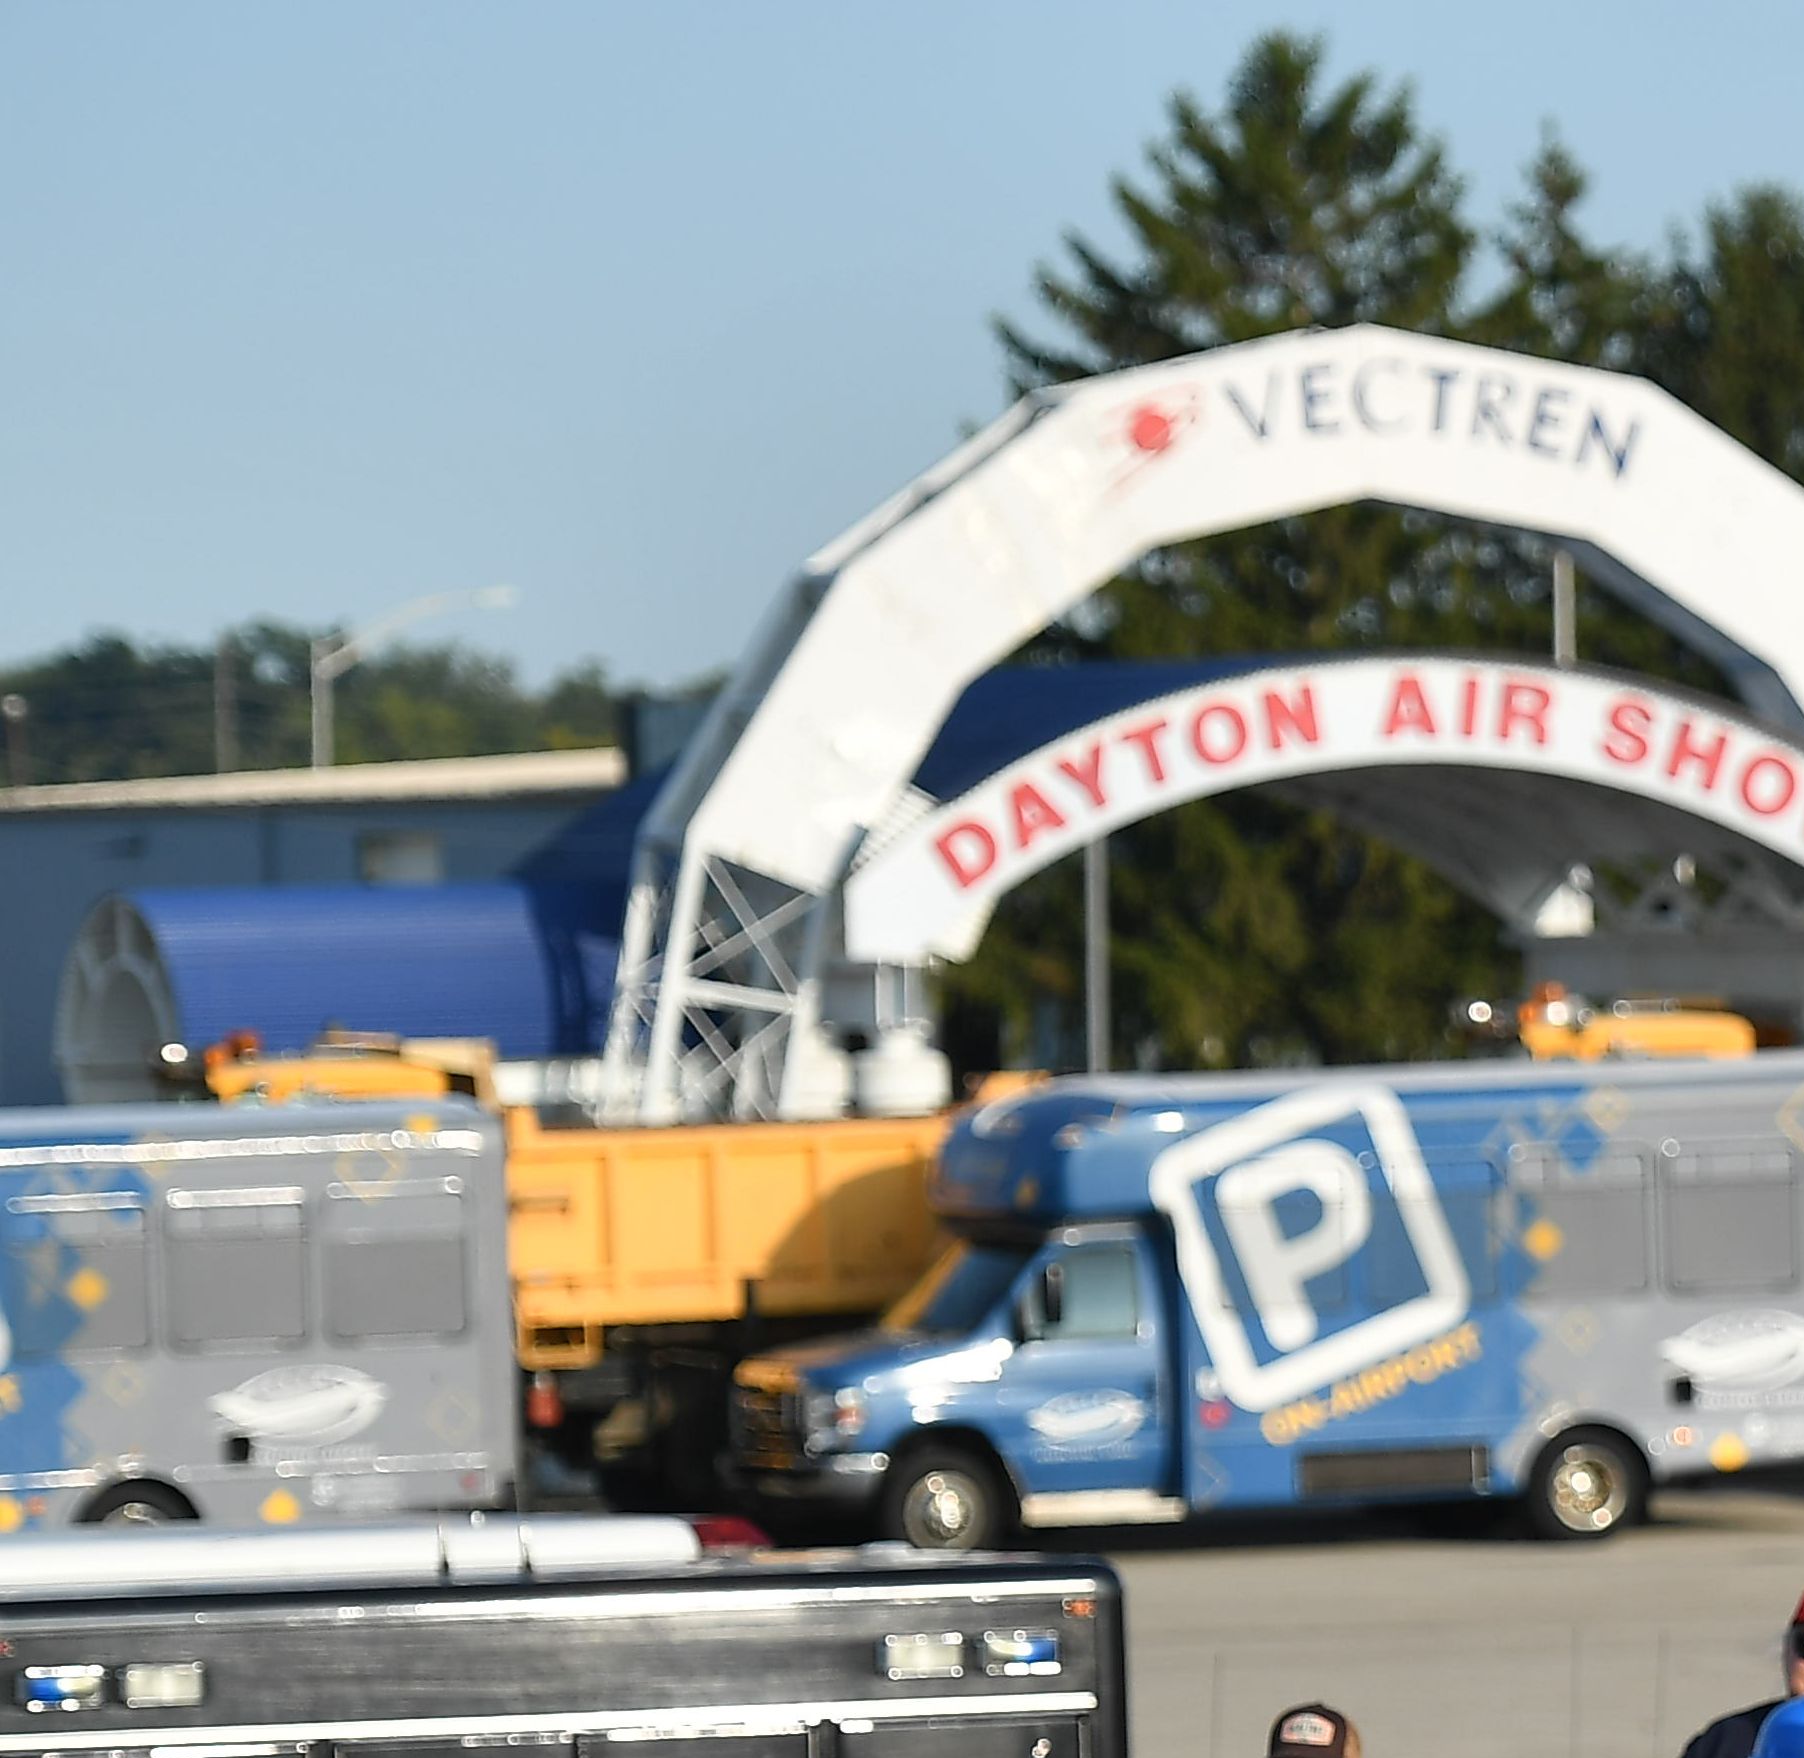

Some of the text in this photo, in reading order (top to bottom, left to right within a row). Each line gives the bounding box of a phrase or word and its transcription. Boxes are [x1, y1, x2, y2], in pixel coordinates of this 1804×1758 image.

[1223, 356, 1639, 478] VECTREN
[931, 677, 1320, 888] DAYTON
[1384, 675, 1549, 745] AIR
[1215, 1138, 1372, 1353] P
